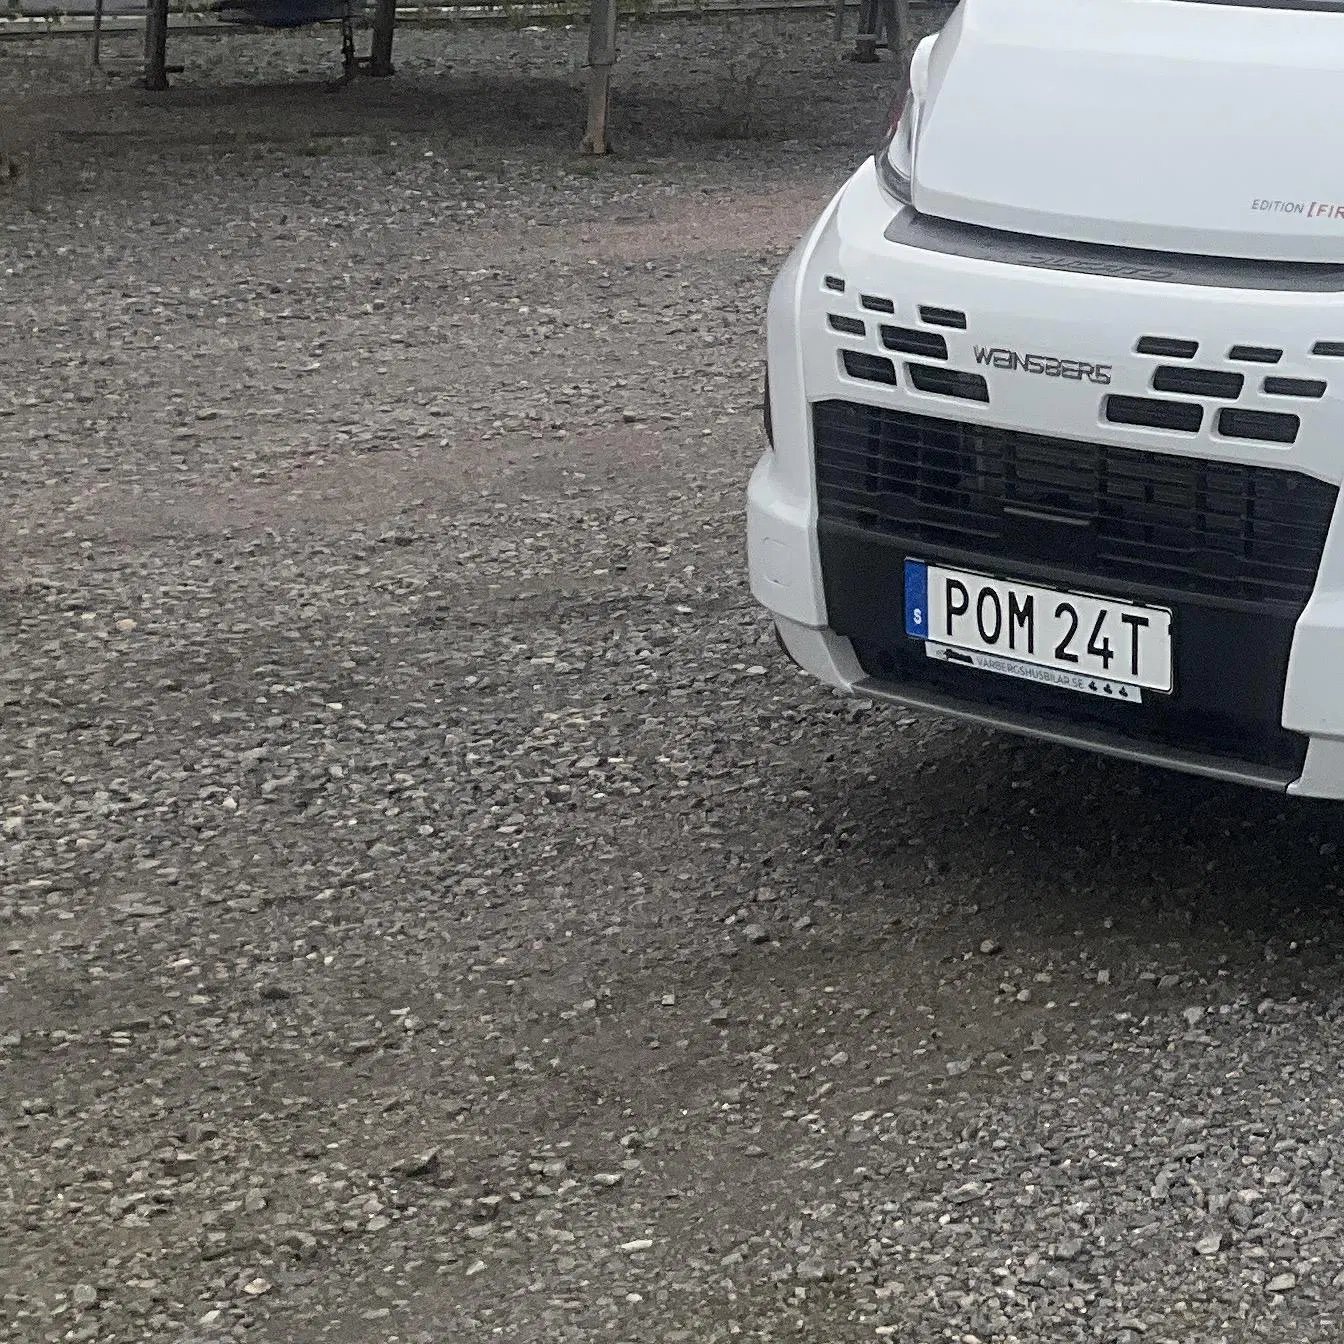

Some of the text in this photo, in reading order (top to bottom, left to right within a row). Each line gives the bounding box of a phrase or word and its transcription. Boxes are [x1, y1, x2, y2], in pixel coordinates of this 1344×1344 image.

[1250, 198, 1305, 214] EDITION
[973, 345, 1113, 385] WEINSBERG
[912, 608, 922, 625] S
[945, 577, 1150, 676] POM 24T
